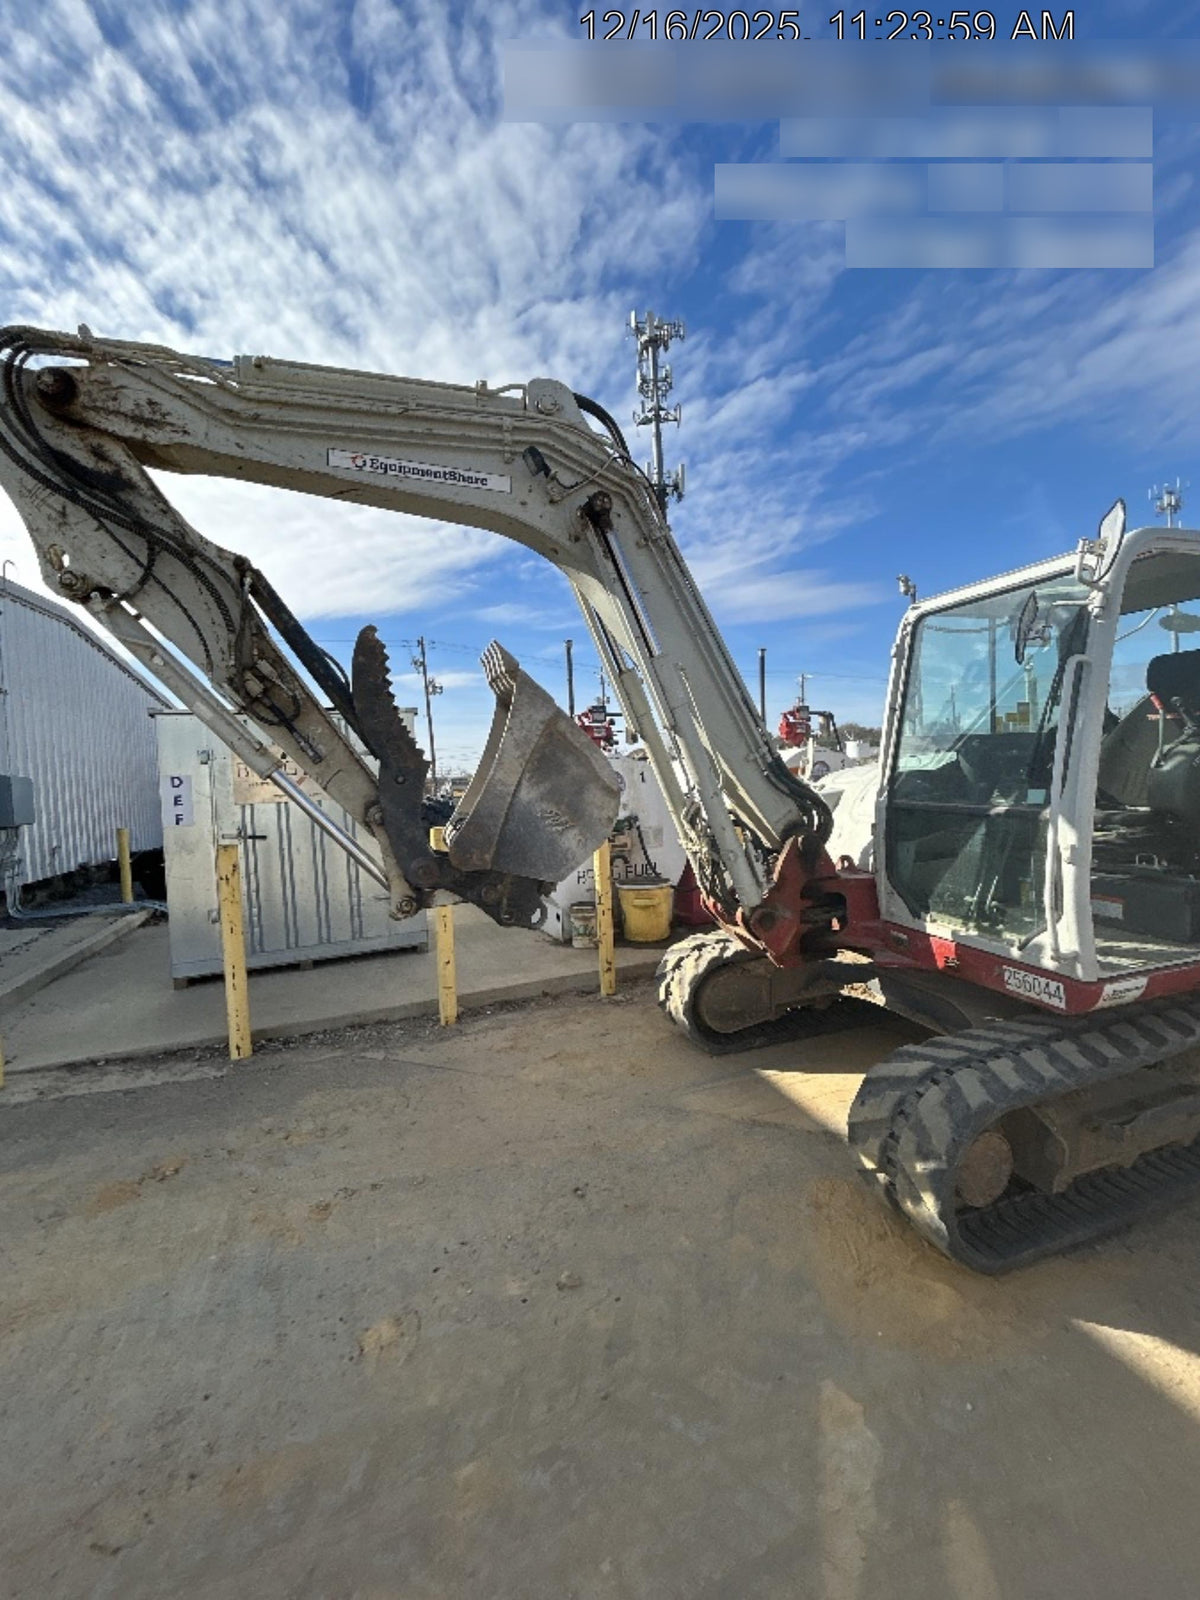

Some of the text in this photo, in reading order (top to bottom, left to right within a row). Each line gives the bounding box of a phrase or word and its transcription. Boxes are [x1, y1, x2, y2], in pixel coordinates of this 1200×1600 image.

[369, 457, 489, 487] EquipmentShare
[625, 861, 662, 879] FUEL
[1006, 968, 1063, 1003] 256044
